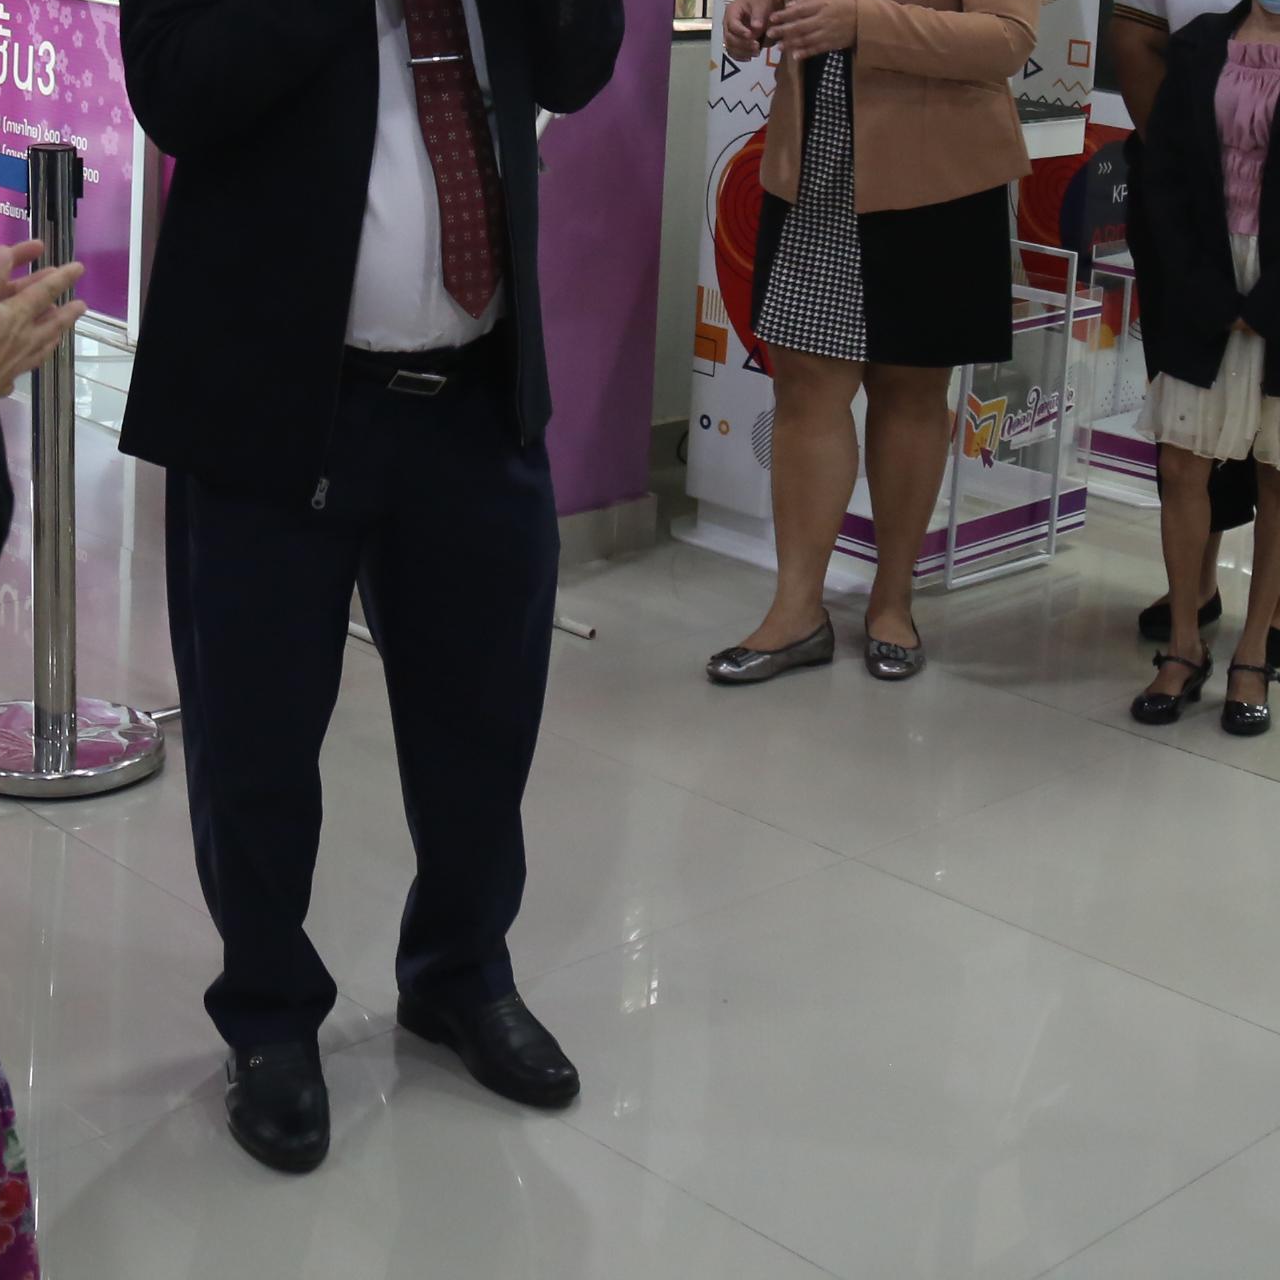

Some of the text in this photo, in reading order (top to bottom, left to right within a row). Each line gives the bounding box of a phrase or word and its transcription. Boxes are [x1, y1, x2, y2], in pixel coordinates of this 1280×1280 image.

[2, 115, 42, 142] (ภาษาไทย)
[43, 129, 61, 144] 600
[70, 134, 88, 150] 900
